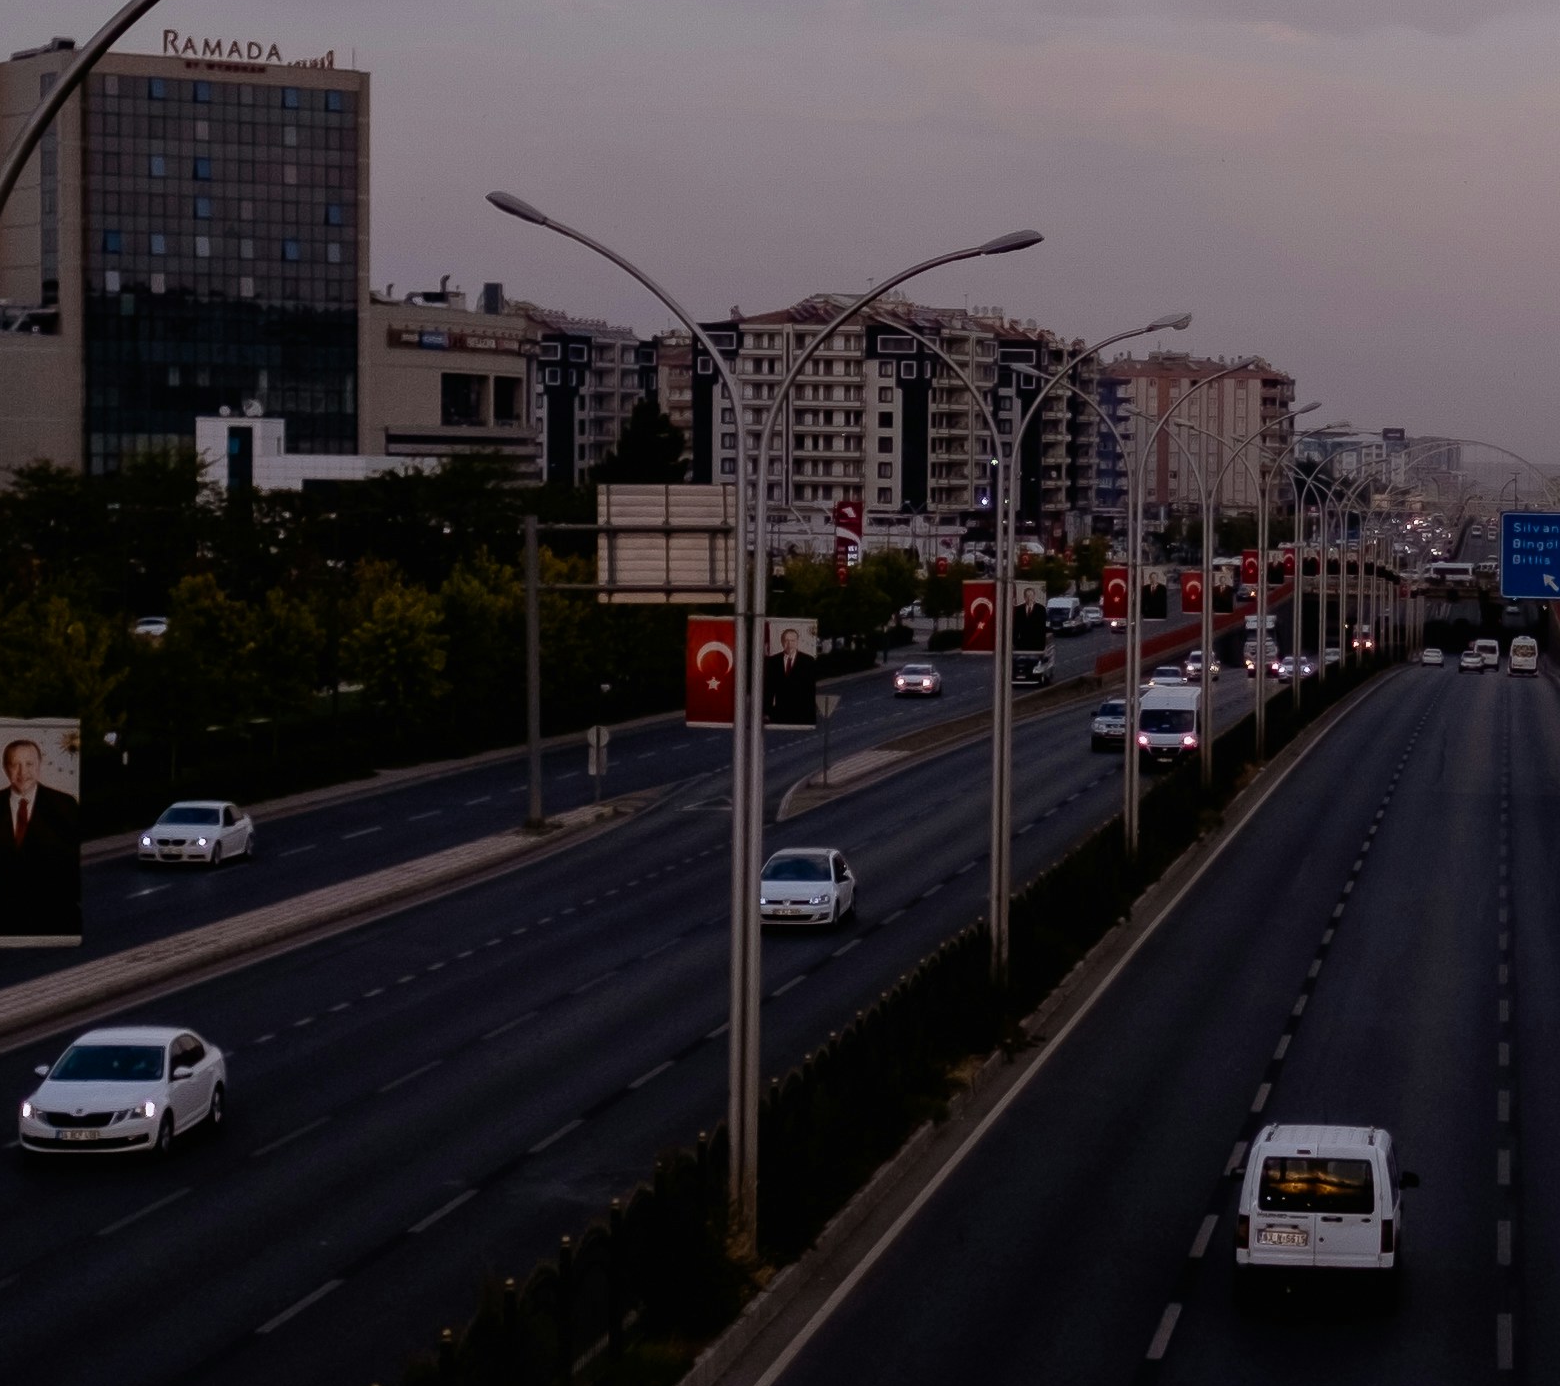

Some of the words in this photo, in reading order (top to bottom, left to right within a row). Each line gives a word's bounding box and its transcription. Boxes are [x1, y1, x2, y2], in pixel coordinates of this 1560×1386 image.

[163, 29, 281, 62] RAMADA
[1513, 522, 1559, 533] Silvan
[1513, 538, 1558, 551] Bingöl
[1513, 554, 1551, 565] Bitlis
